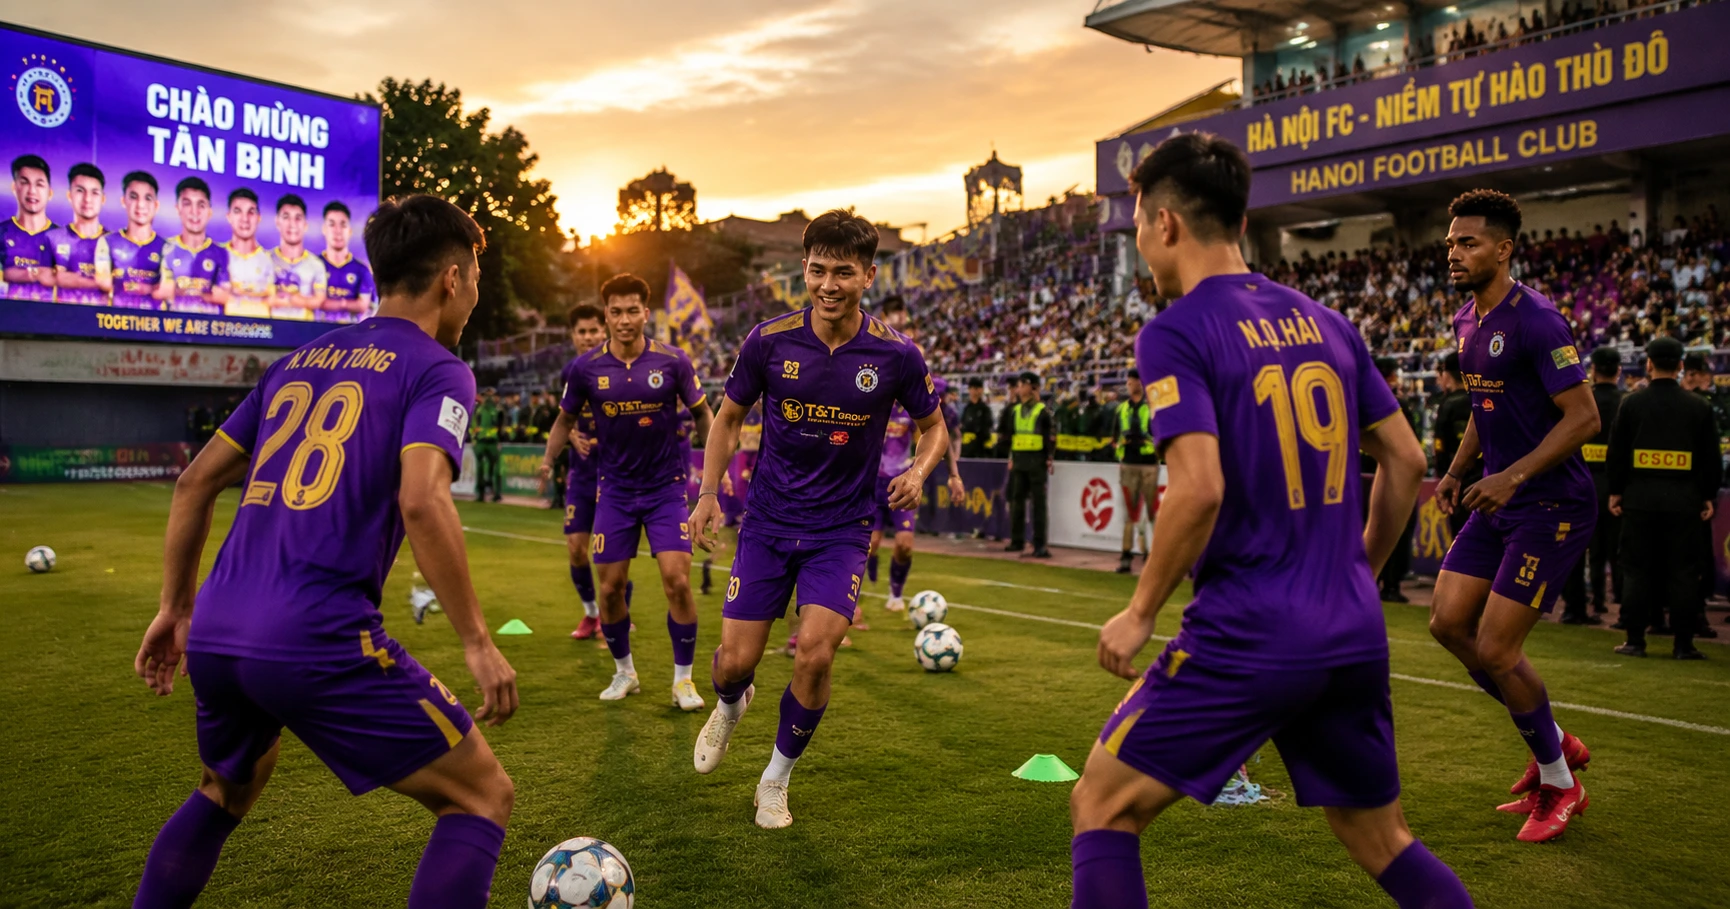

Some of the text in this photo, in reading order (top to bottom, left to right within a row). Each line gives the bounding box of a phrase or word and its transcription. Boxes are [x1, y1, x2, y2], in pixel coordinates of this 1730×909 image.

[146, 83, 330, 149] CHÀO MỪNG
[1282, 105, 1319, 150] NỘI
[1326, 103, 1354, 139] FC
[1448, 70, 1485, 118] TỰ
[1489, 61, 1547, 107] HÀO
[236, 142, 326, 190] BINH
[1291, 120, 1599, 194] HANOI FOOTBALL CLUB
[96, 312, 160, 332] TOGETHER
[163, 317, 183, 335] WE
[184, 318, 210, 336] ARE
[805, 403, 841, 419] T&T
[1253, 361, 1348, 510] 19
[241, 381, 364, 511] 28
[1638, 451, 1688, 467] CSCD
